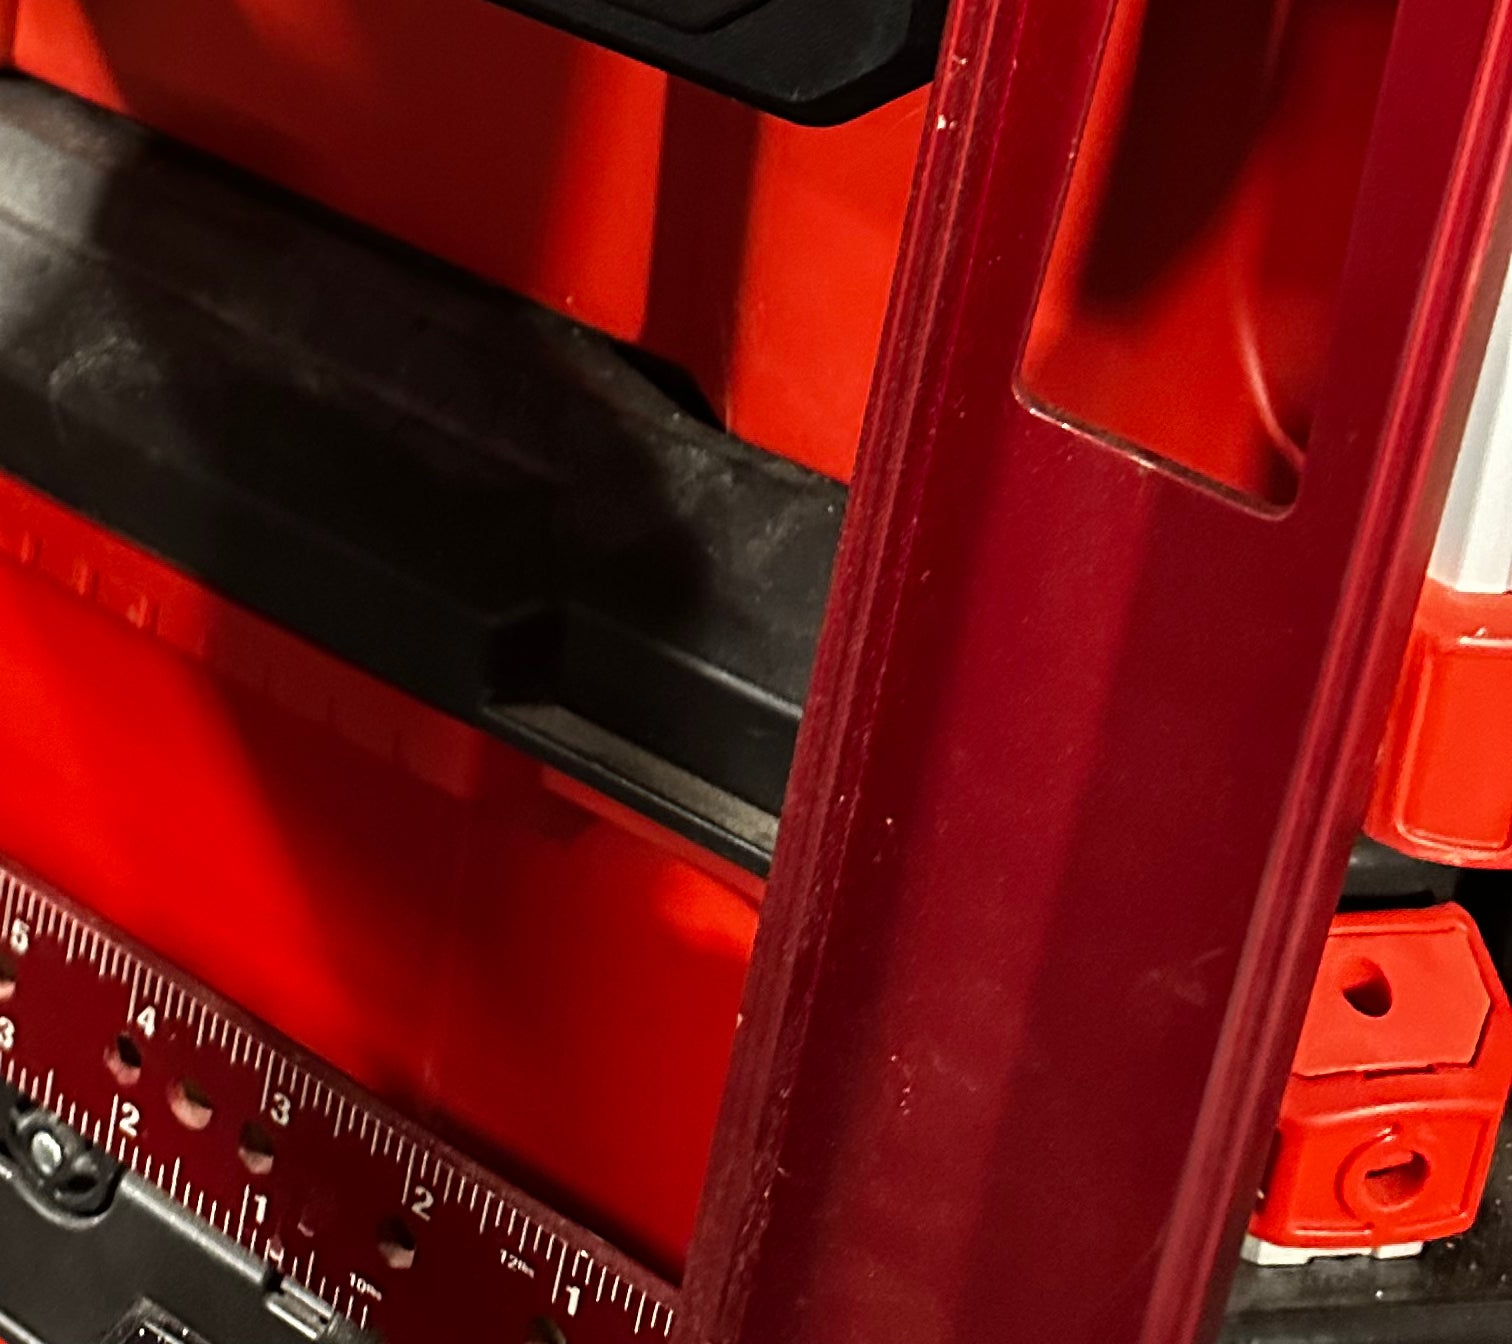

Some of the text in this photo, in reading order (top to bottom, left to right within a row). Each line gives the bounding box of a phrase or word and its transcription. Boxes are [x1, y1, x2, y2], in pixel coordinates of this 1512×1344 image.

[10, 918, 30, 955] 5
[137, 1005, 156, 1039] 4
[271, 1092, 290, 1126] 3
[411, 1185, 434, 1221] 2
[566, 1286, 581, 1317] 1
[119, 1102, 140, 1137] 2
[254, 1194, 267, 1225] 1
